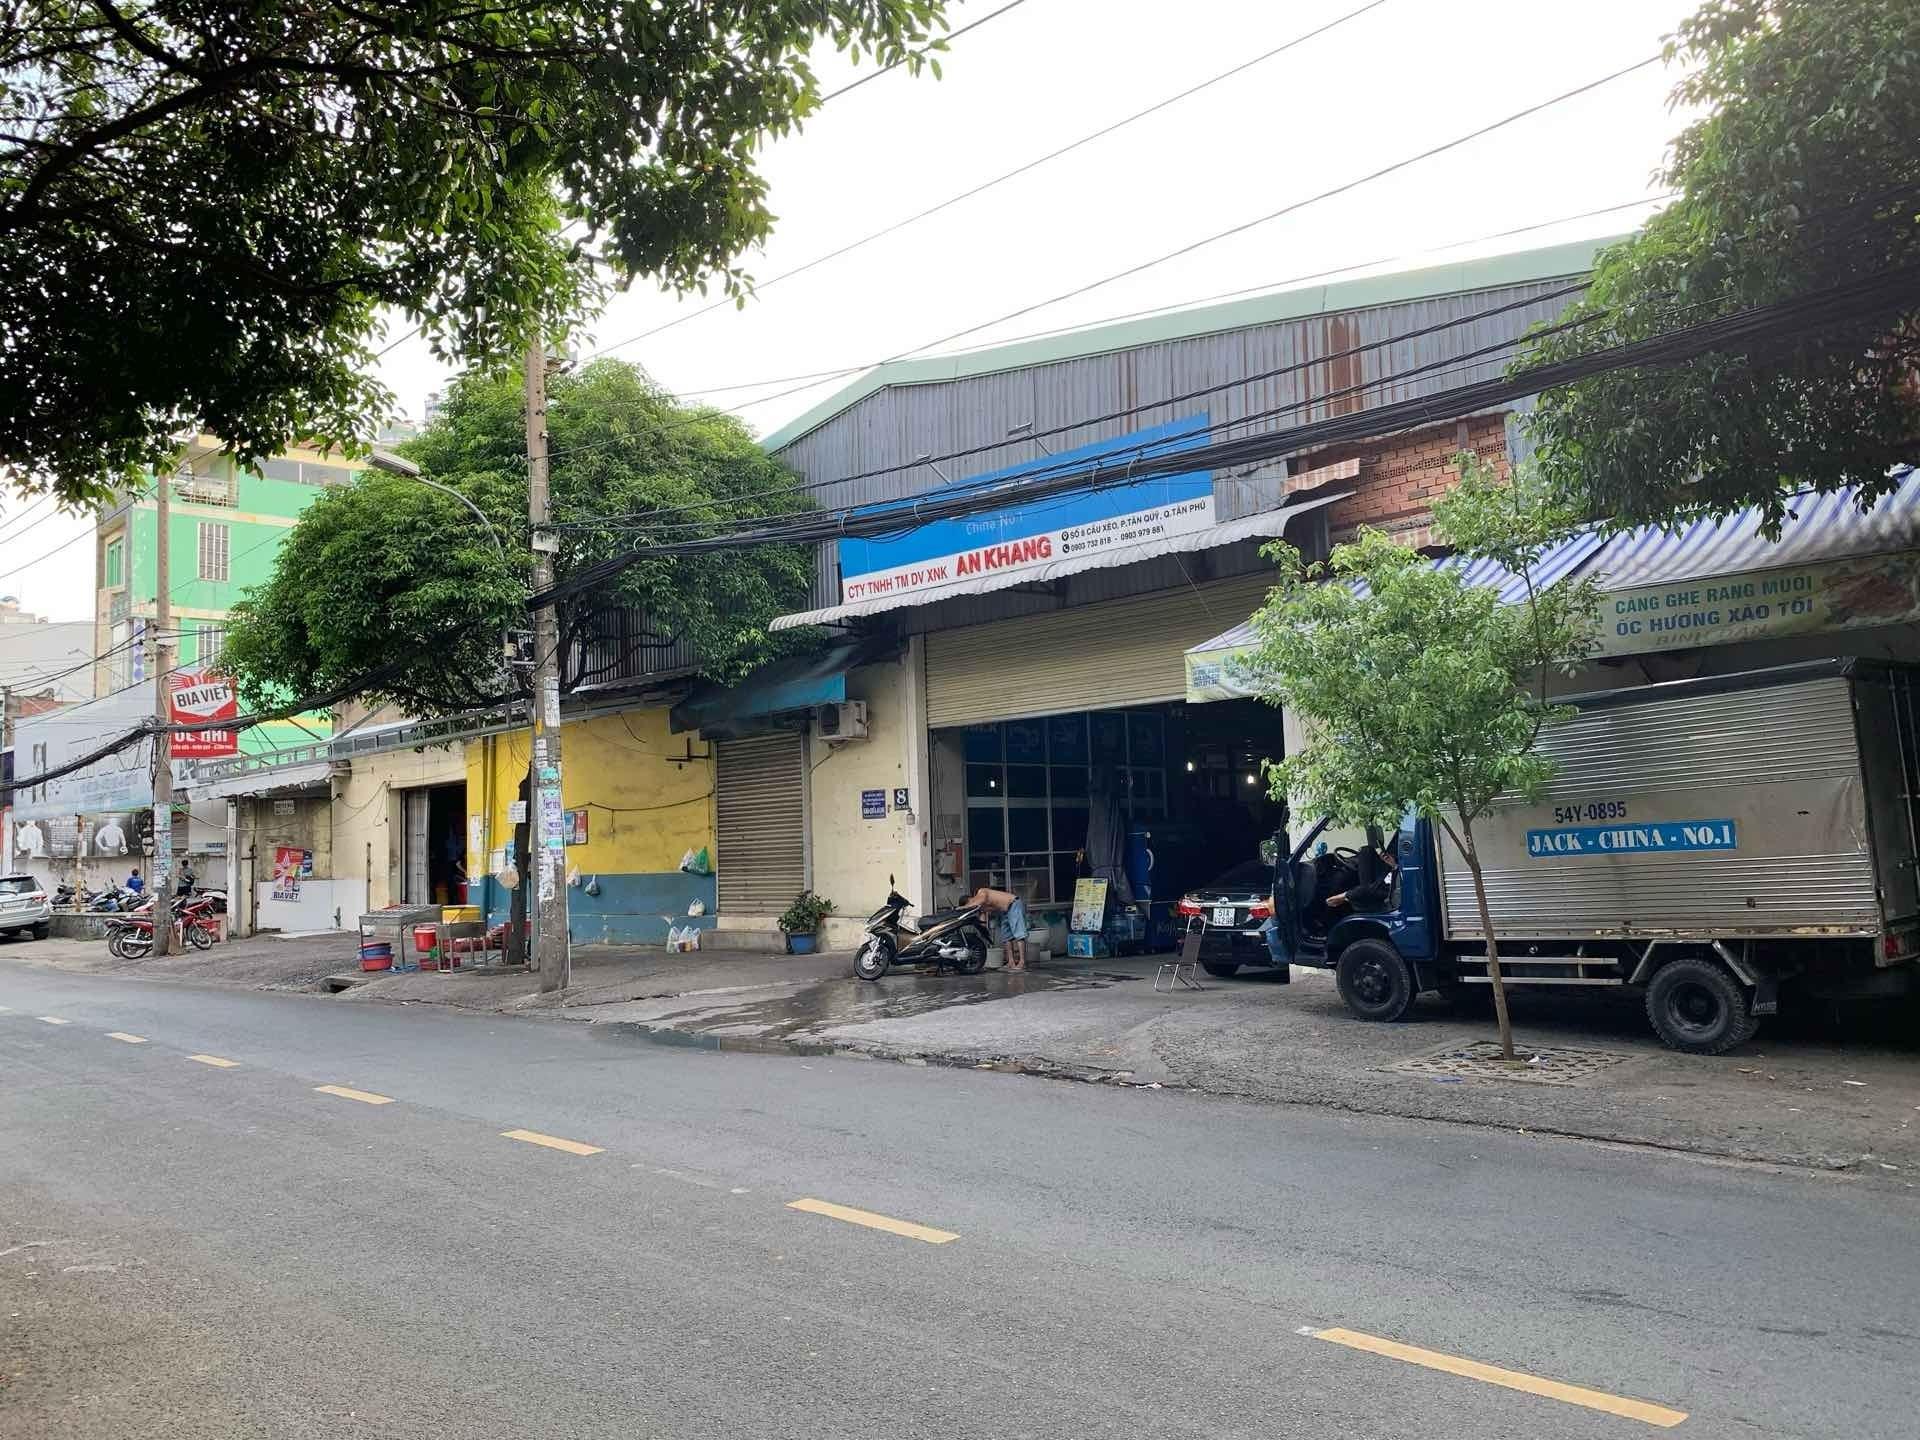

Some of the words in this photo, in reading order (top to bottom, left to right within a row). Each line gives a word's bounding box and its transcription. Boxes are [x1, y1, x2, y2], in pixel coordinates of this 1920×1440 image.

[848, 584, 865, 599] CTY
[868, 578, 893, 595] TNHH
[895, 575, 909, 588] TM
[911, 571, 926, 586] DV
[927, 566, 948, 582] XNK
[955, 550, 982, 577] AN
[983, 535, 1052, 573] KHANG
[176, 691, 200, 707] BIA
[896, 789, 906, 805] 8
[1554, 800, 1627, 824] 54Y-0895
[1531, 832, 1583, 853] JACK
[1599, 828, 1665, 850] CHINA
[1682, 824, 1731, 846] NO.1
